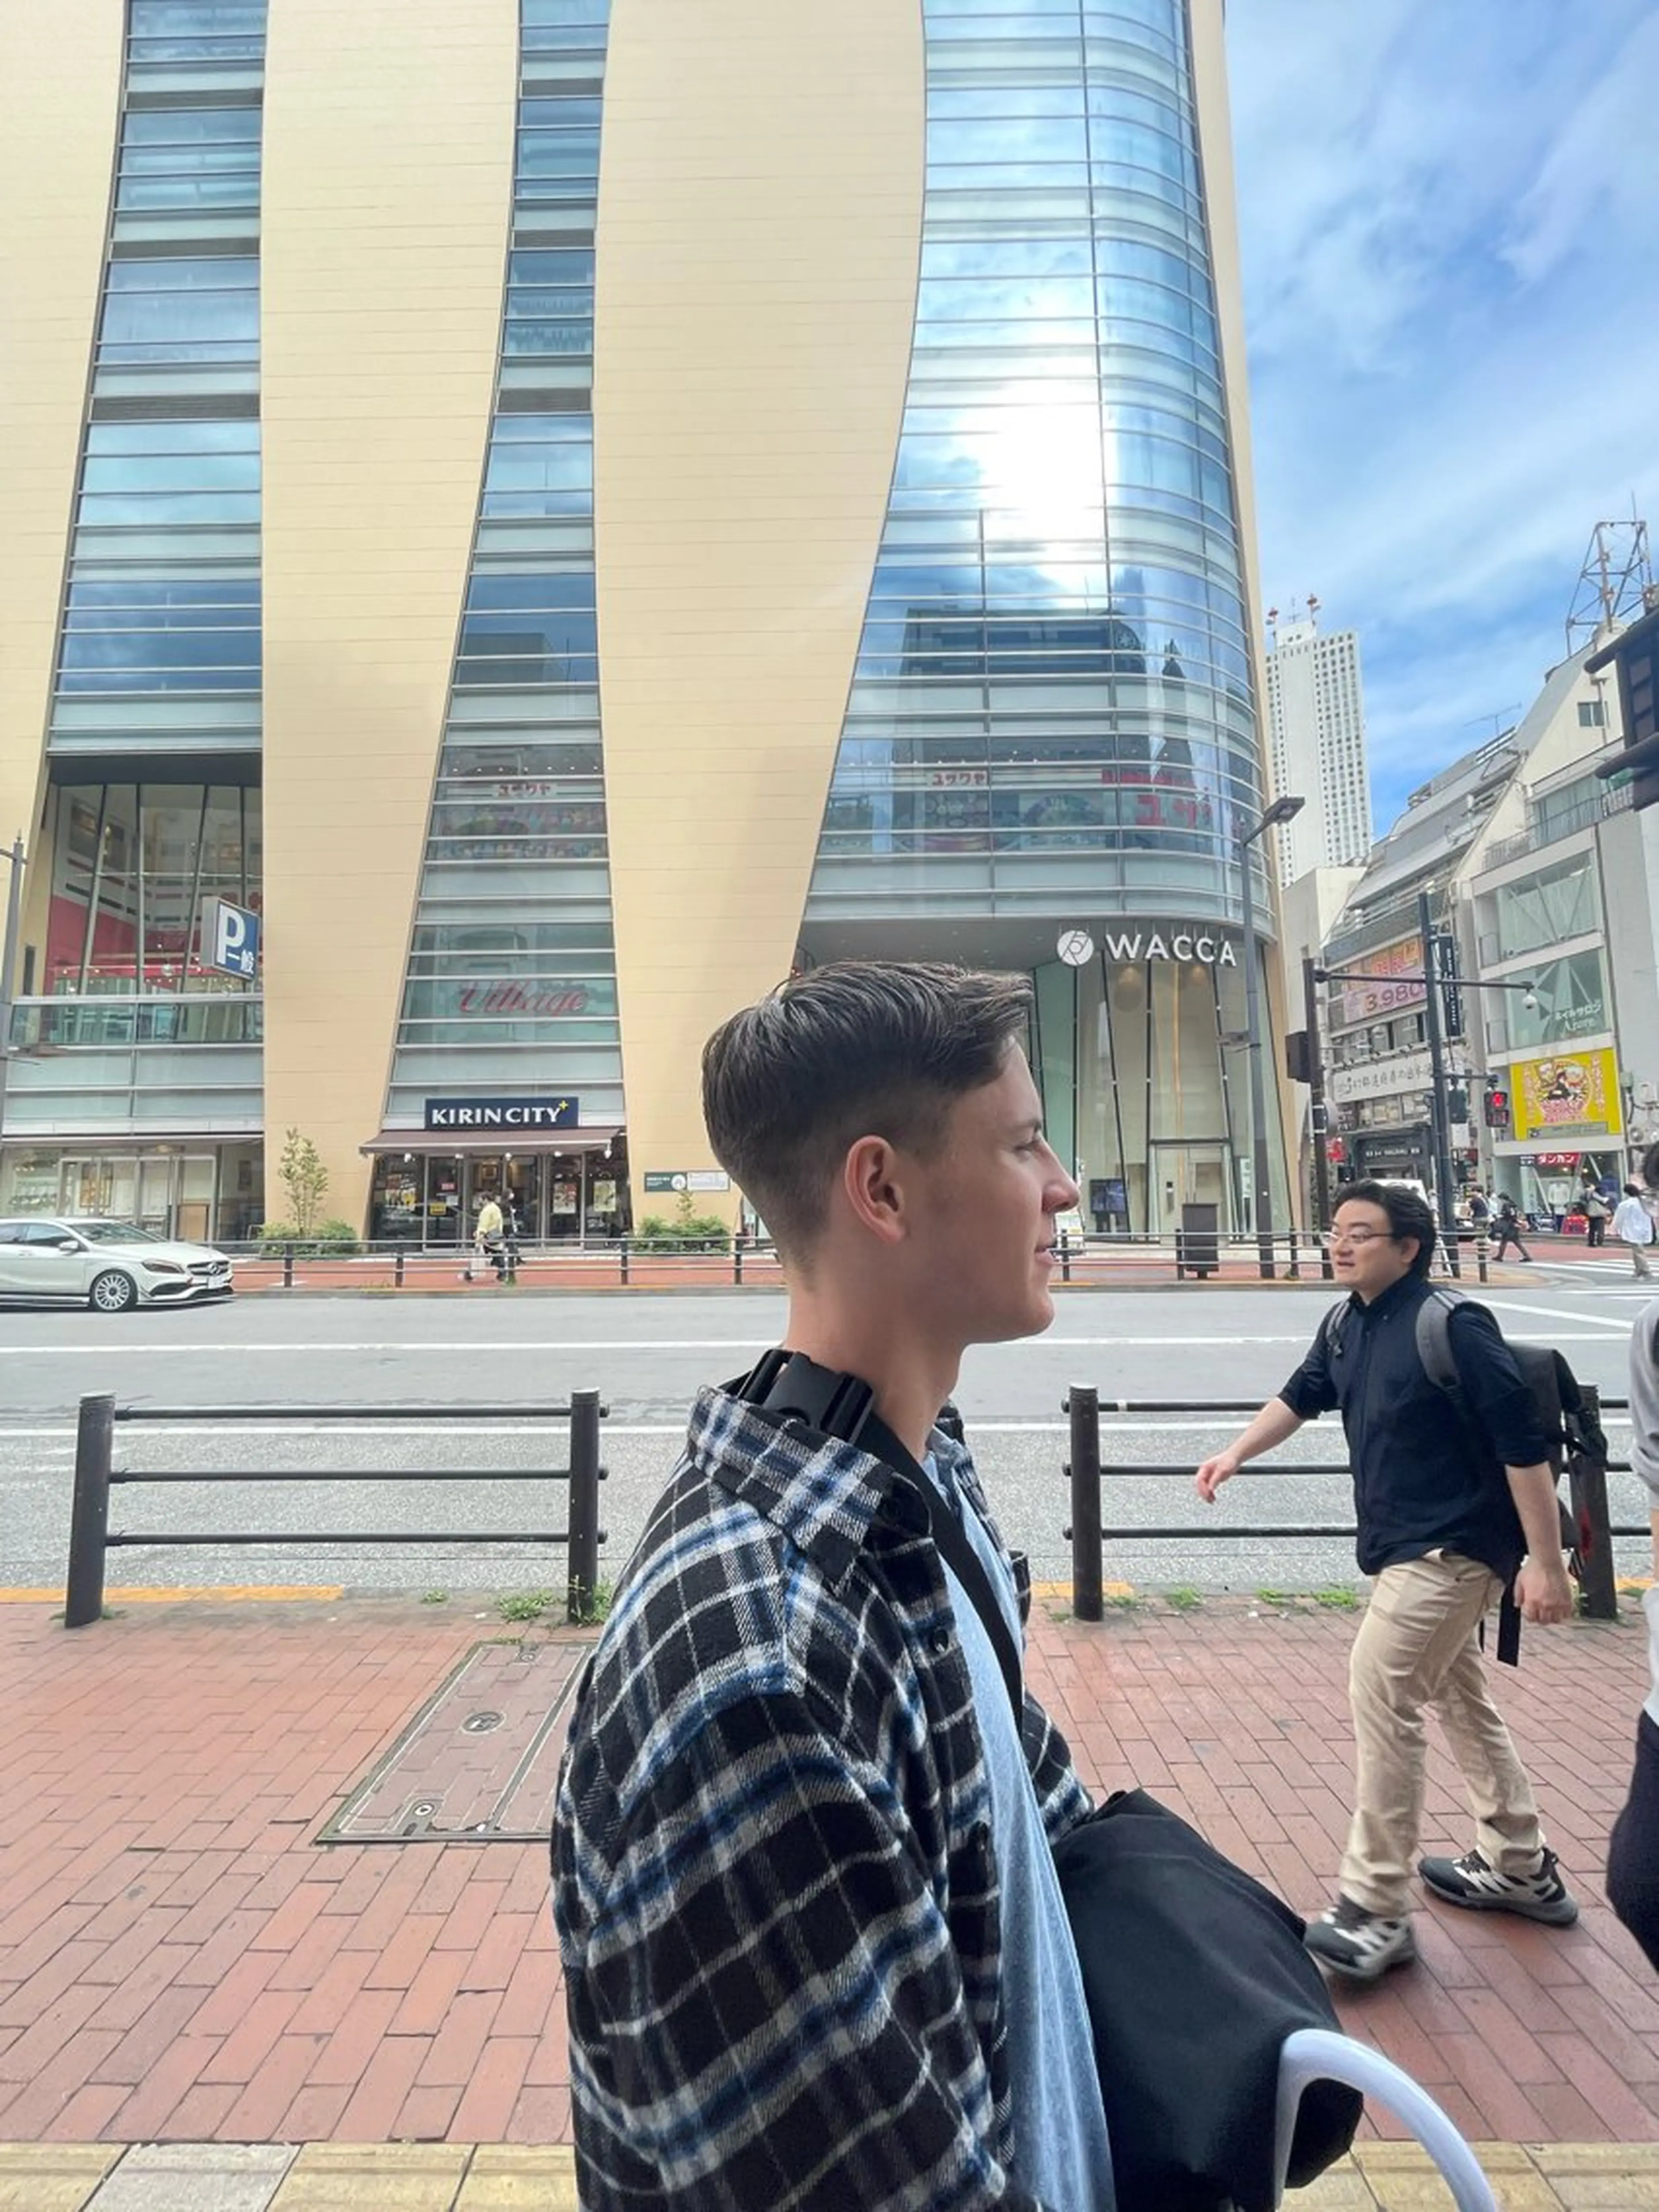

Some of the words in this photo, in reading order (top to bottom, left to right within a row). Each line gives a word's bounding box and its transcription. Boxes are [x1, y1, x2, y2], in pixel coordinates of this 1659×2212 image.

[932, 773, 985, 785] ユザワヤ
[216, 903, 246, 965] P
[1105, 933, 1237, 967] WACCA
